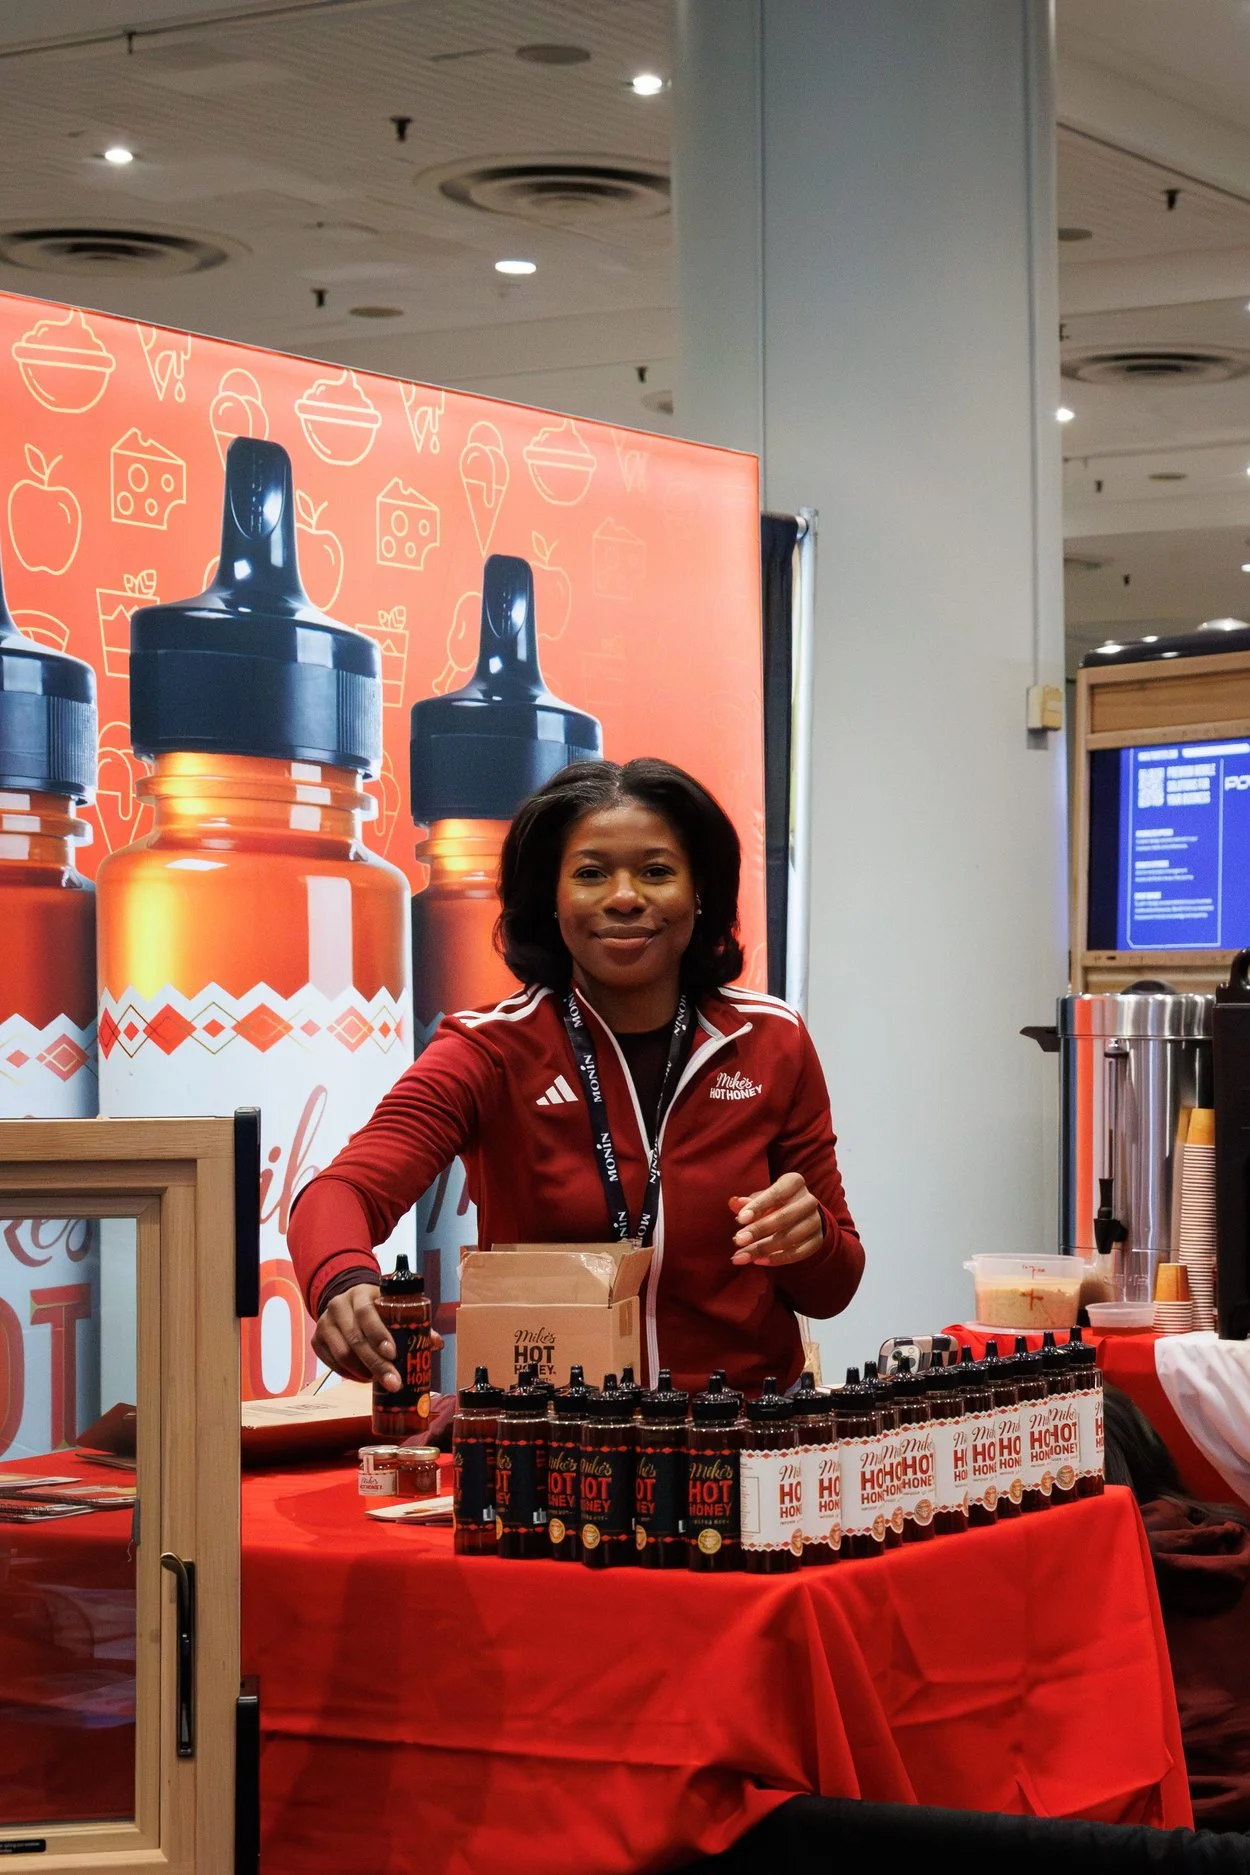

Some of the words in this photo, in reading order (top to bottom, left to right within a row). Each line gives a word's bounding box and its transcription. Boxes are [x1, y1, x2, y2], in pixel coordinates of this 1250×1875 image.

[716, 1071, 753, 1090] Mike's
[514, 1326, 557, 1344] Mike's
[407, 1350, 431, 1373] HO
[514, 1345, 555, 1364] HOT
[999, 1435, 1021, 1458] HO
[1030, 1429, 1050, 1450] HO
[972, 1441, 996, 1464] HO
[689, 1458, 734, 1480] Mike's
[860, 1467, 884, 1491] HO
[883, 1461, 901, 1483] HO
[636, 1478, 657, 1500] OT
[688, 1480, 734, 1503] HOT
[779, 1481, 802, 1505] HO
[818, 1475, 840, 1499] HO
[689, 1503, 733, 1517] HONEY
